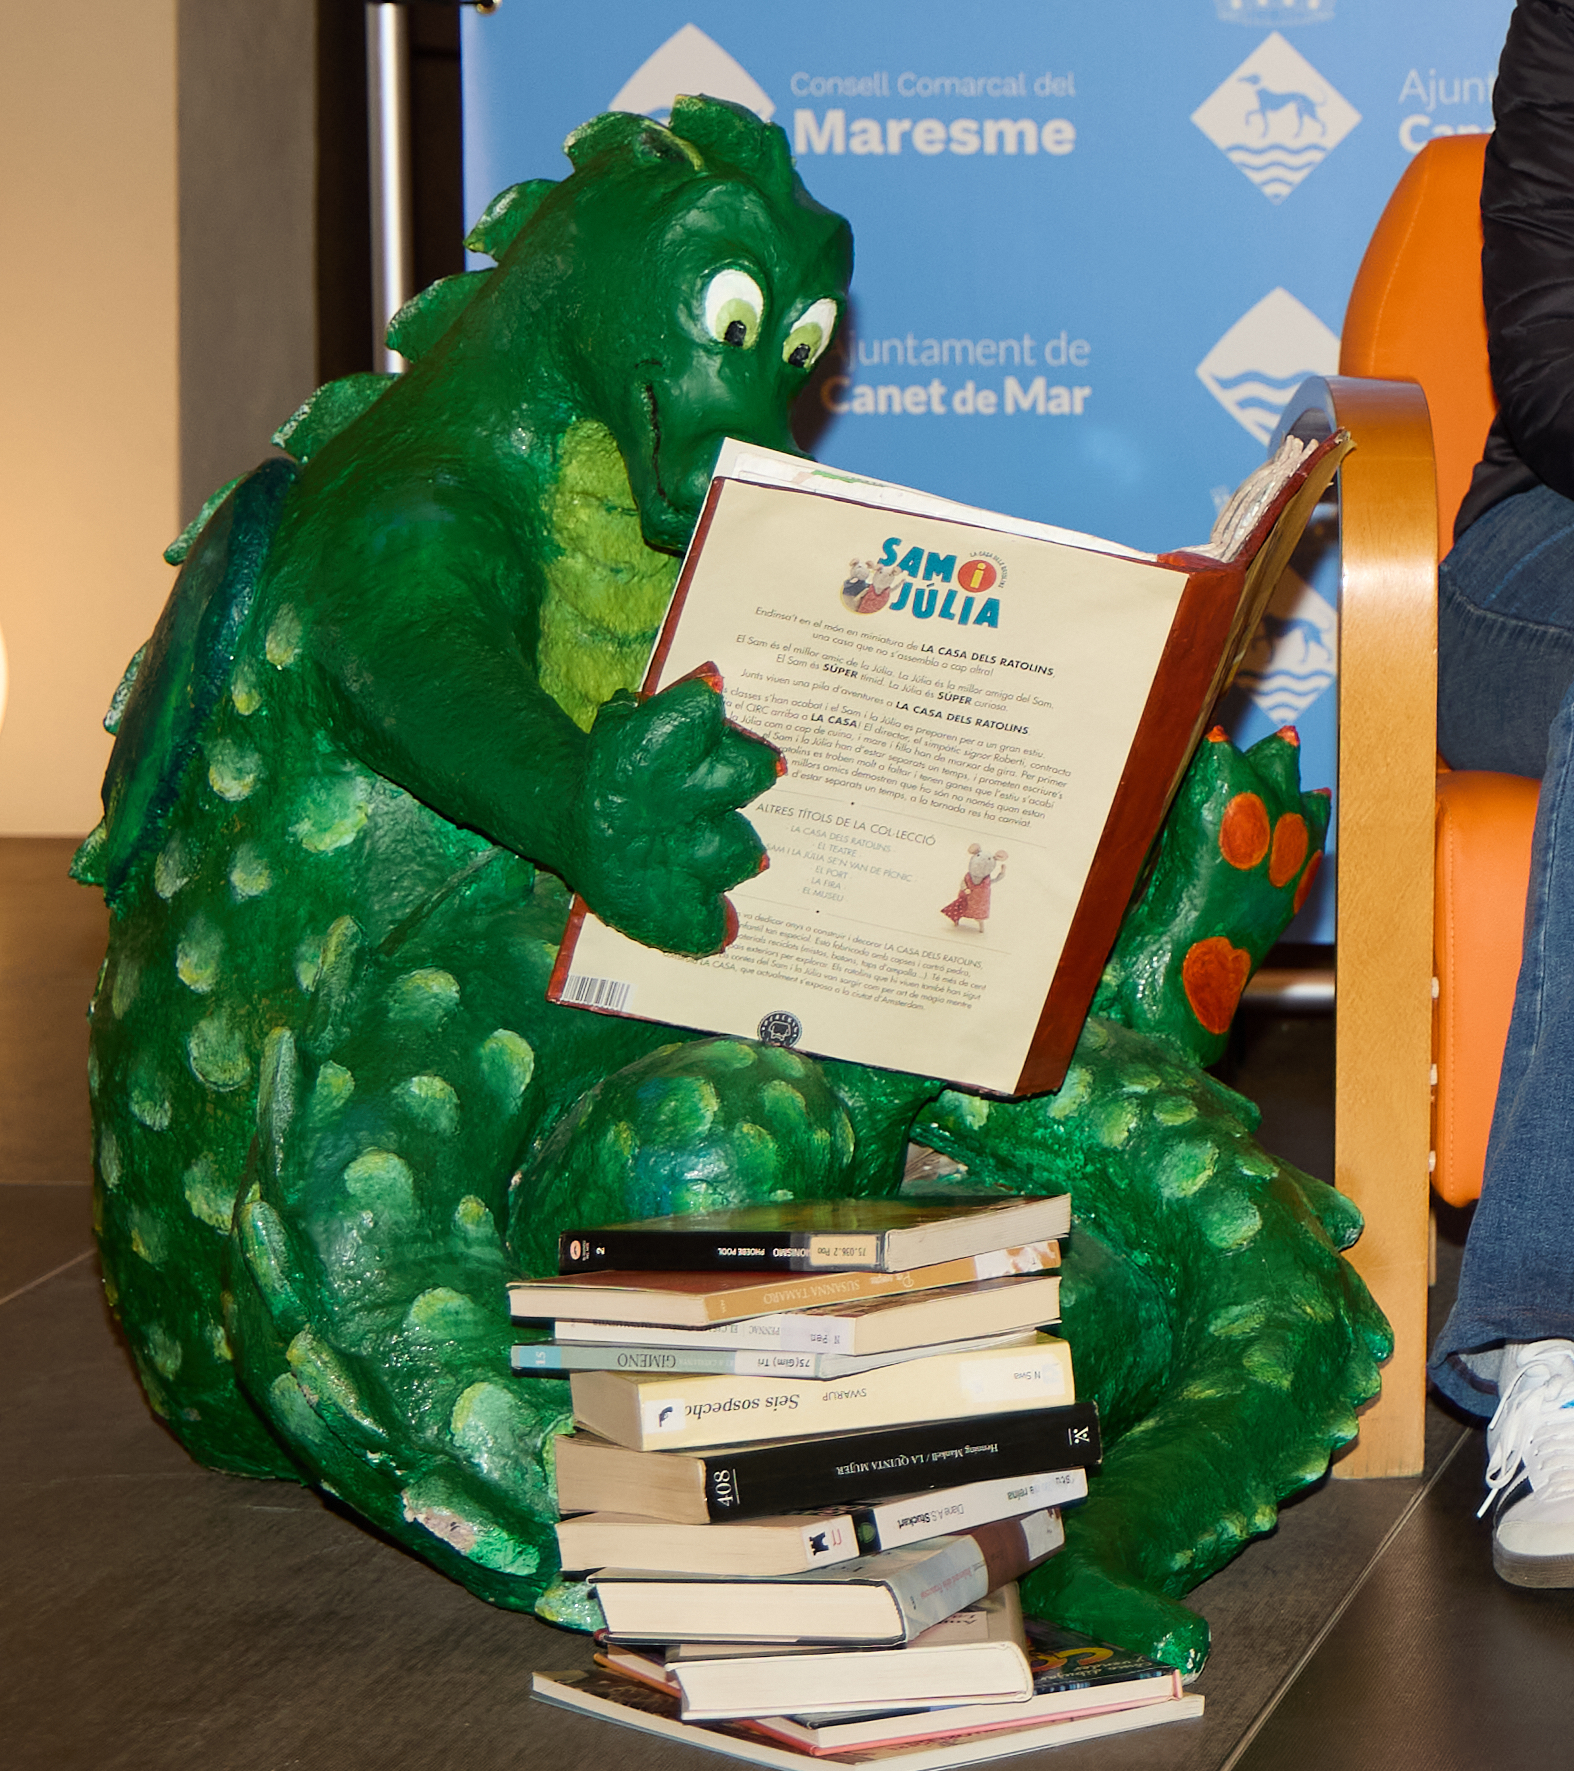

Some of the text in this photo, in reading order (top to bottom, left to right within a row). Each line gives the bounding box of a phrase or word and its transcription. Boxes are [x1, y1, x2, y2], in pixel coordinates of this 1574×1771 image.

[1045, 330, 1092, 366] de
[821, 376, 1092, 416] Canet de Mar
[877, 537, 957, 583] SAM
[969, 562, 986, 589] i
[889, 582, 1000, 628] JÚLIA
[921, 643, 934, 654] LA
[938, 646, 967, 660] CASA
[971, 652, 997, 665] DELS
[822, 662, 859, 679] SÚPER
[937, 690, 973, 706] SÚPER
[896, 701, 909, 712] LA
[913, 705, 943, 719] CASA
[946, 712, 972, 725] DELS
[755, 802, 795, 817] ALTRES
[798, 808, 834, 825] TÍTOLS
[836, 816, 850, 828] DE
[853, 819, 867, 831] LA
[763, 1288, 809, 1305] TAMARO
[811, 1281, 861, 1297] SUSANNA
[617, 1352, 677, 1369] GIMENO
[764, 1393, 801, 1412] Seis
[822, 1387, 868, 1402] SWARUP
[836, 1461, 870, 1476] MUJER
[870, 1455, 910, 1472] QUINTA
[910, 1453, 925, 1464] LA
[713, 1469, 735, 1508] 408
